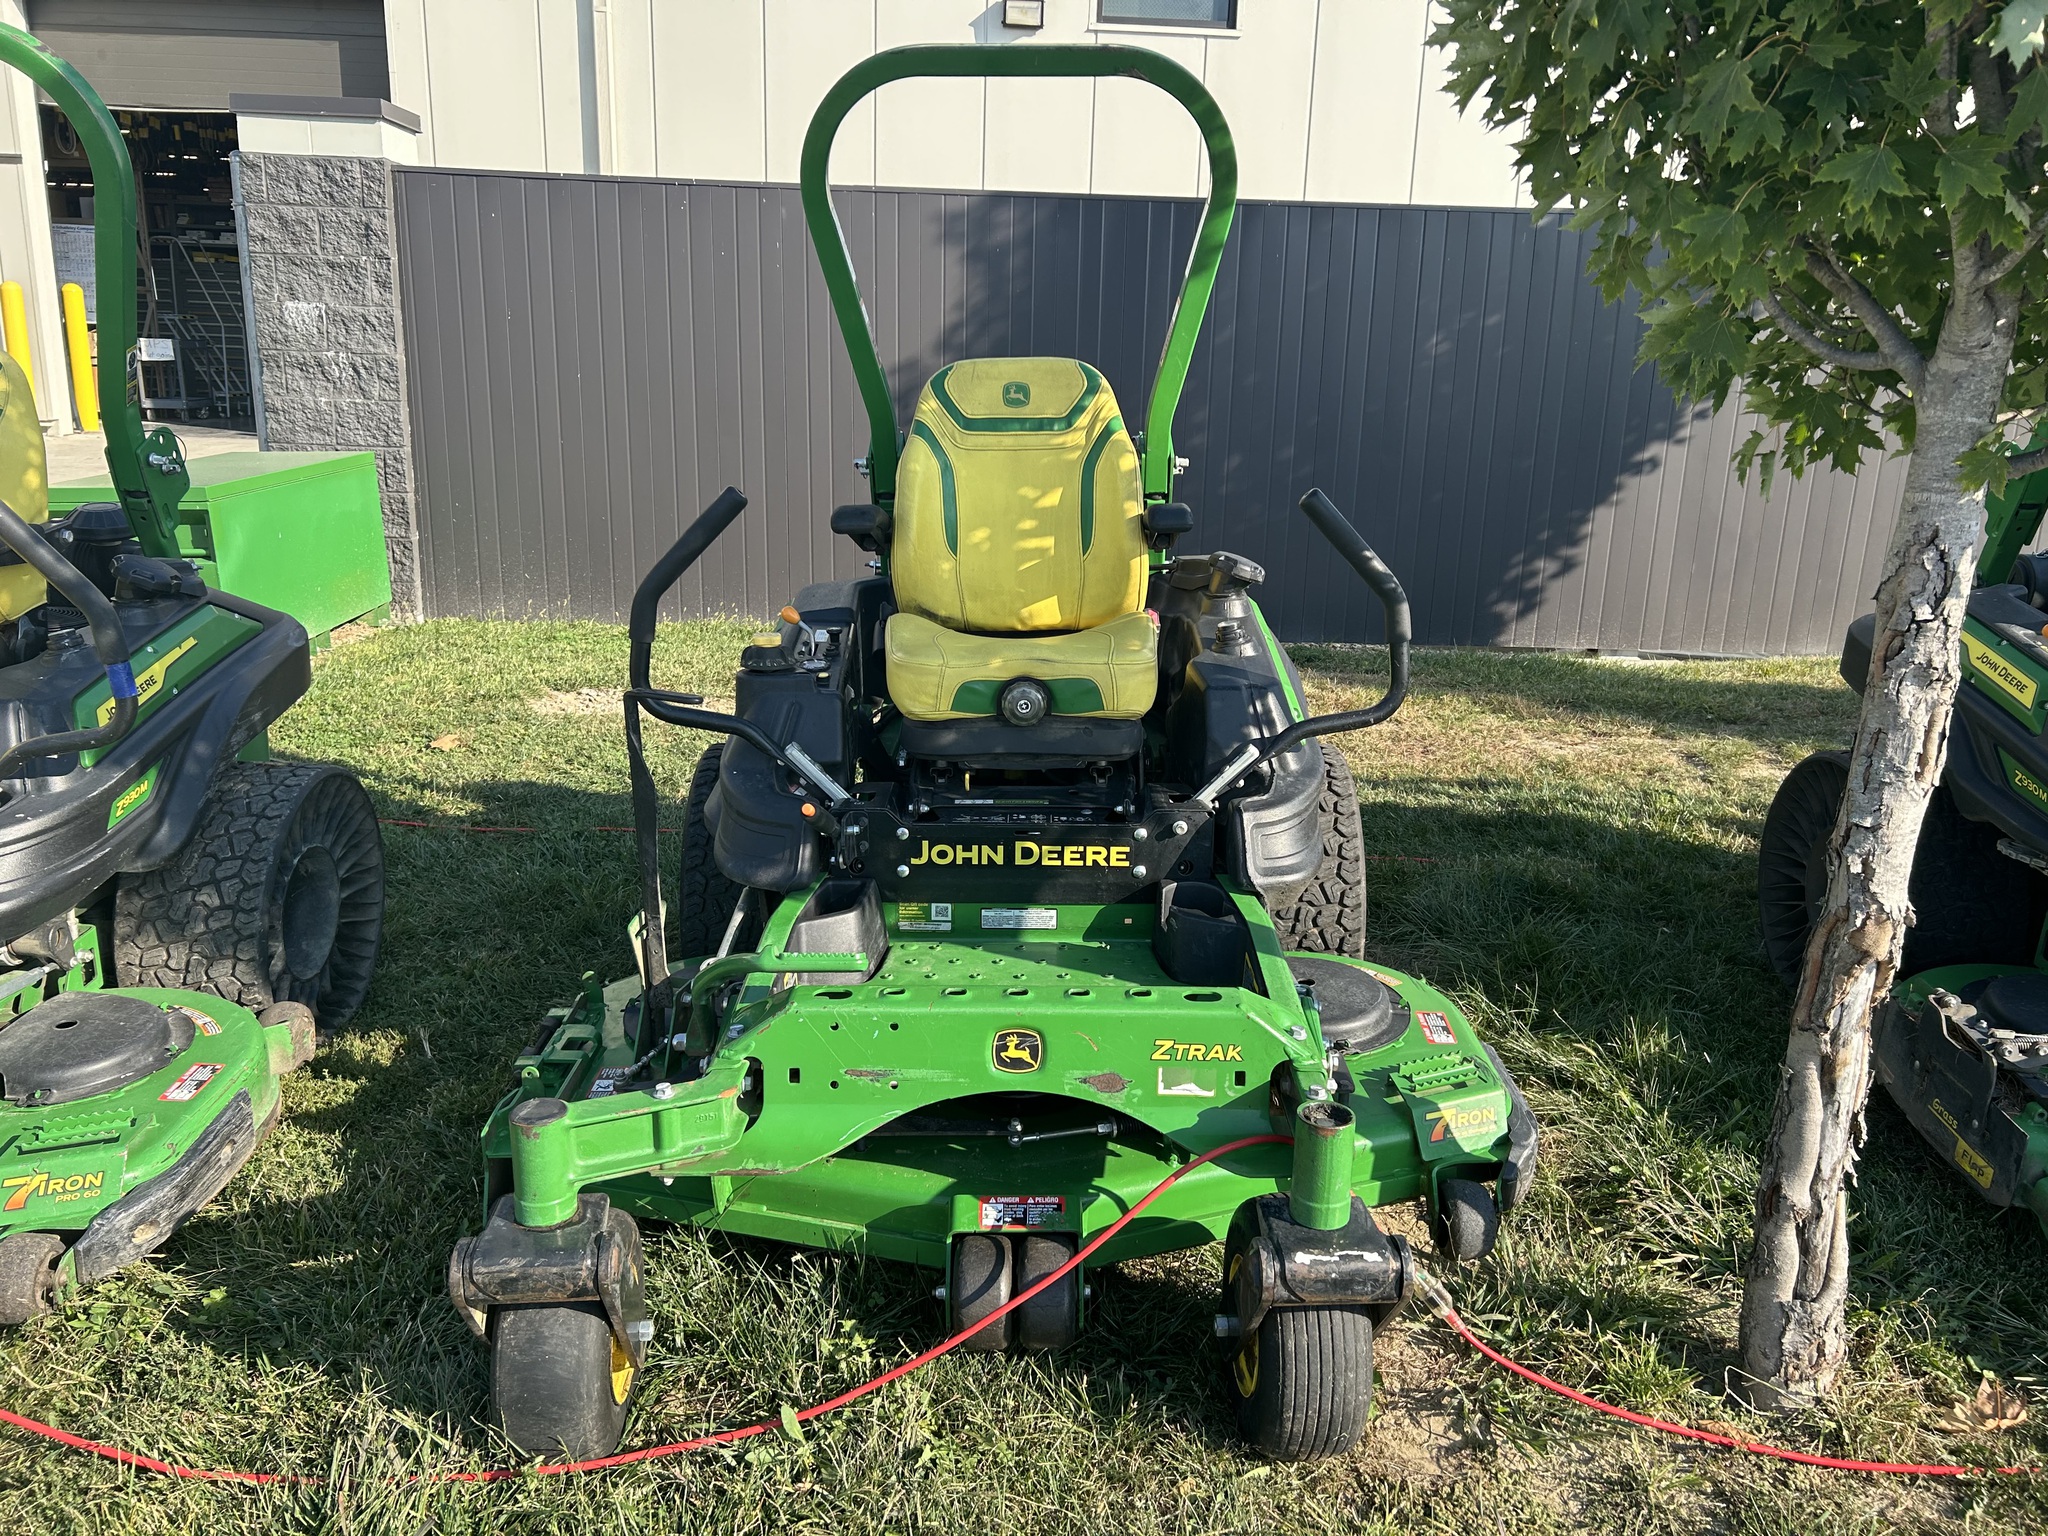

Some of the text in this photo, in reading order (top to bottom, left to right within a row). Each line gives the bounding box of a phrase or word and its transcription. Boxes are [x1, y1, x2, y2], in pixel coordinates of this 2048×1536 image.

[1976, 652, 2029, 694] JOHN DEERE
[116, 780, 148, 818] Z930M
[2014, 769, 2048, 803] Z930M
[911, 840, 1130, 866] JOHN DEERE
[1150, 1039, 1243, 1061] ZTRAK
[1932, 1098, 1959, 1130] Grass
[55, 1189, 101, 1204] PRO 60
